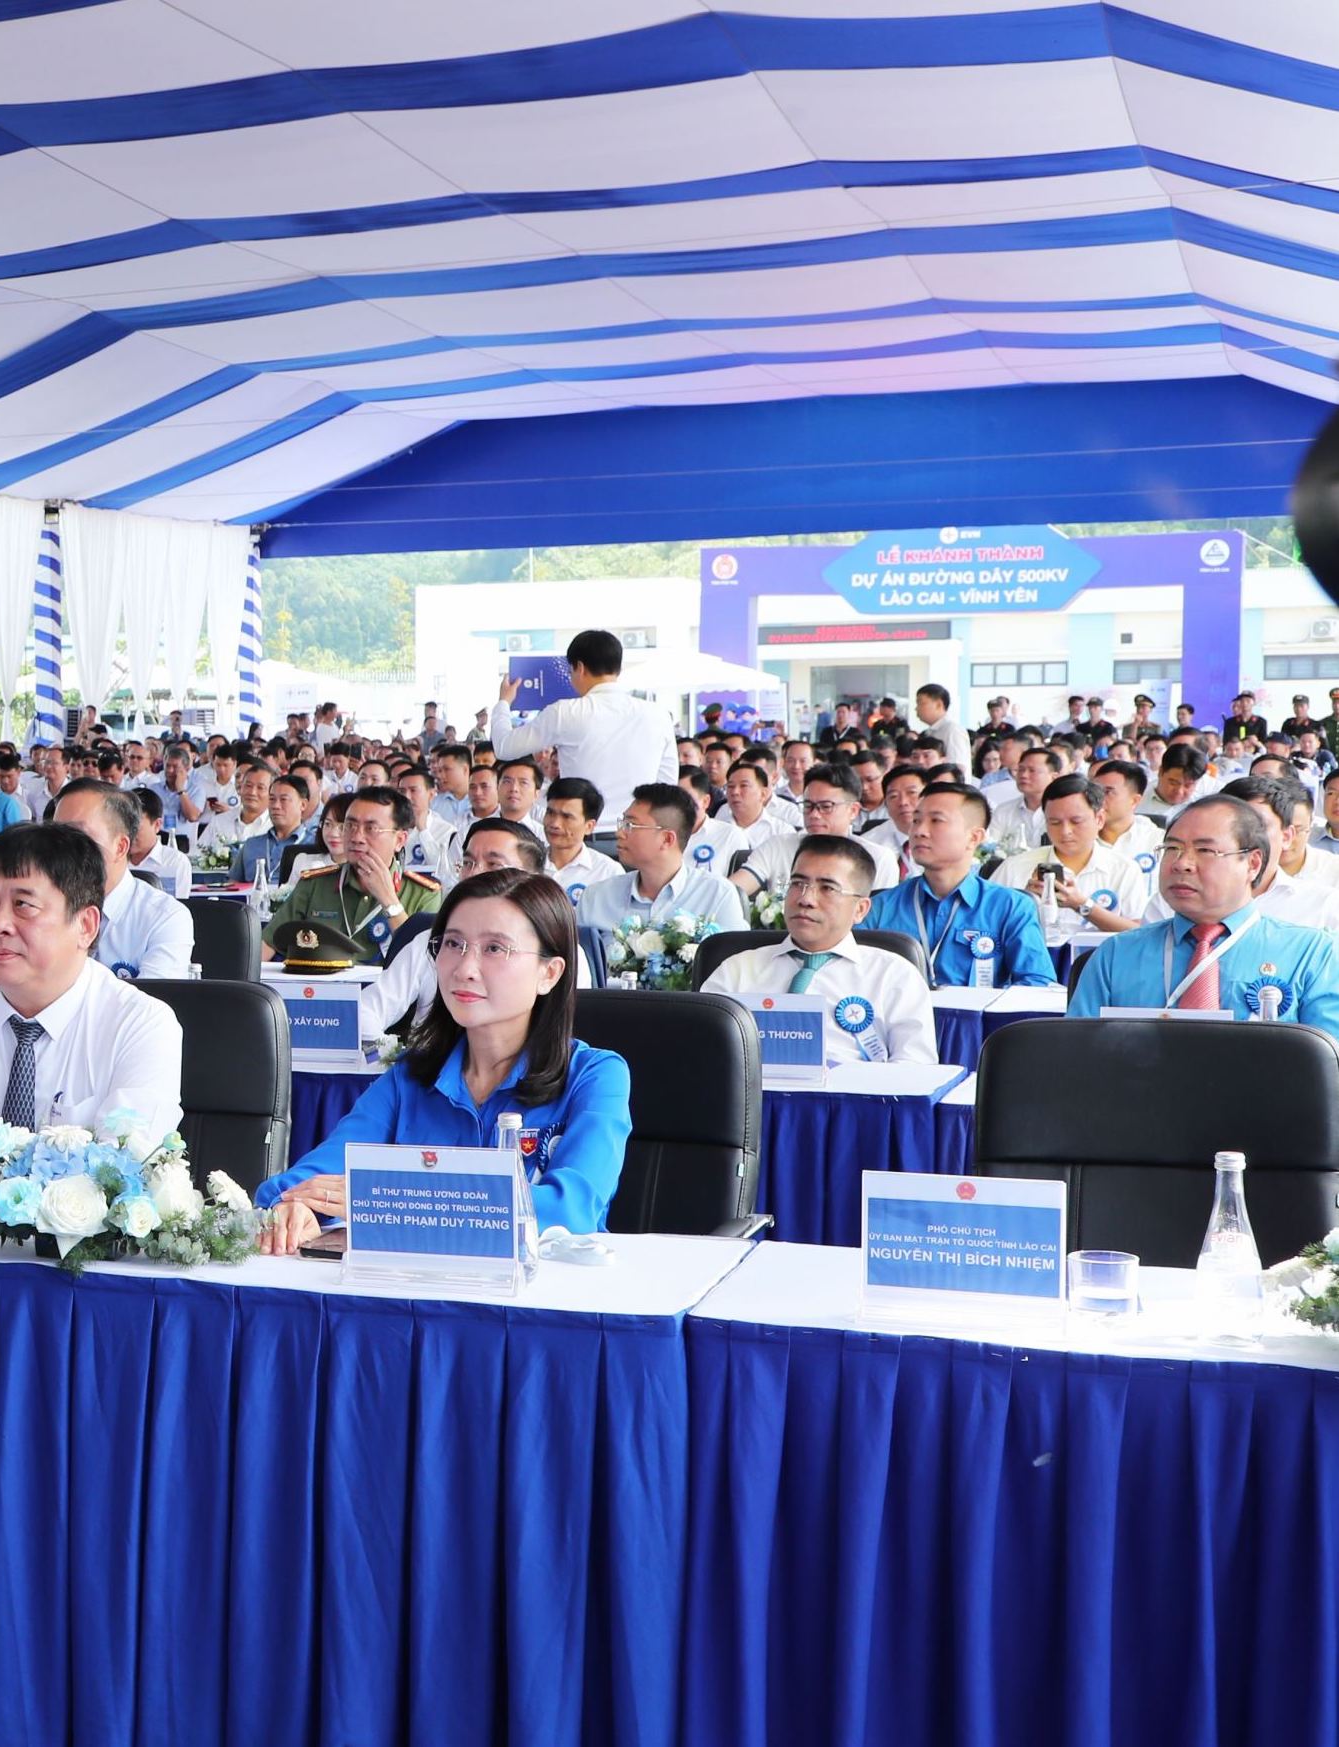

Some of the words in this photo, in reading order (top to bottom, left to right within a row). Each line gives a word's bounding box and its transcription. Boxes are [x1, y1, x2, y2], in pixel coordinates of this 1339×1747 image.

[877, 545, 901, 564] LỄ
[904, 546, 972, 564] KHÁNH
[977, 545, 1044, 562] THÀNH
[851, 572, 877, 589] DỰ
[882, 570, 905, 586] ÁN
[908, 569, 975, 586] ĐƯỜNG
[979, 568, 1014, 584] DÂY
[1018, 568, 1069, 582] 500KV
[880, 591, 913, 606] LÀO
[917, 592, 945, 604] CAI
[959, 589, 999, 604] VĨNH
[1003, 588, 1038, 603] YÊN
[294, 1016, 312, 1026] XÂY
[314, 1019, 340, 1028] DỰNG
[768, 1030, 813, 1040] THƯƠNG
[372, 1186, 380, 1195] BÍ
[383, 1188, 400, 1196] THƯ
[402, 1189, 432, 1198] TRUNG
[434, 1190, 460, 1199] ƯƠNG
[463, 1192, 488, 1200] ĐOÀN
[372, 1201, 390, 1210] TỊCH
[392, 1201, 407, 1210] HỘI
[435, 1204, 450, 1212] ĐỘI
[452, 1205, 480, 1213] TRUNG
[483, 1206, 509, 1214] ƯƠNG
[353, 1212, 401, 1224] NGUYỄN
[404, 1216, 438, 1228] PHẠM
[441, 1218, 465, 1228] DUY
[468, 1219, 510, 1230] TRANG
[927, 1224, 948, 1234] PHÓ
[950, 1226, 972, 1235] CHỦ
[975, 1228, 996, 1237] TỊCH
[883, 1234, 902, 1242] BAN
[1018, 1241, 1038, 1251] LÀO
[1040, 1244, 1056, 1252] CAI
[870, 1247, 932, 1262] NGUYỄN
[937, 1252, 960, 1266] THỊ
[966, 1254, 1000, 1266] BÍCH
[1006, 1256, 1054, 1272] NHIỆM
